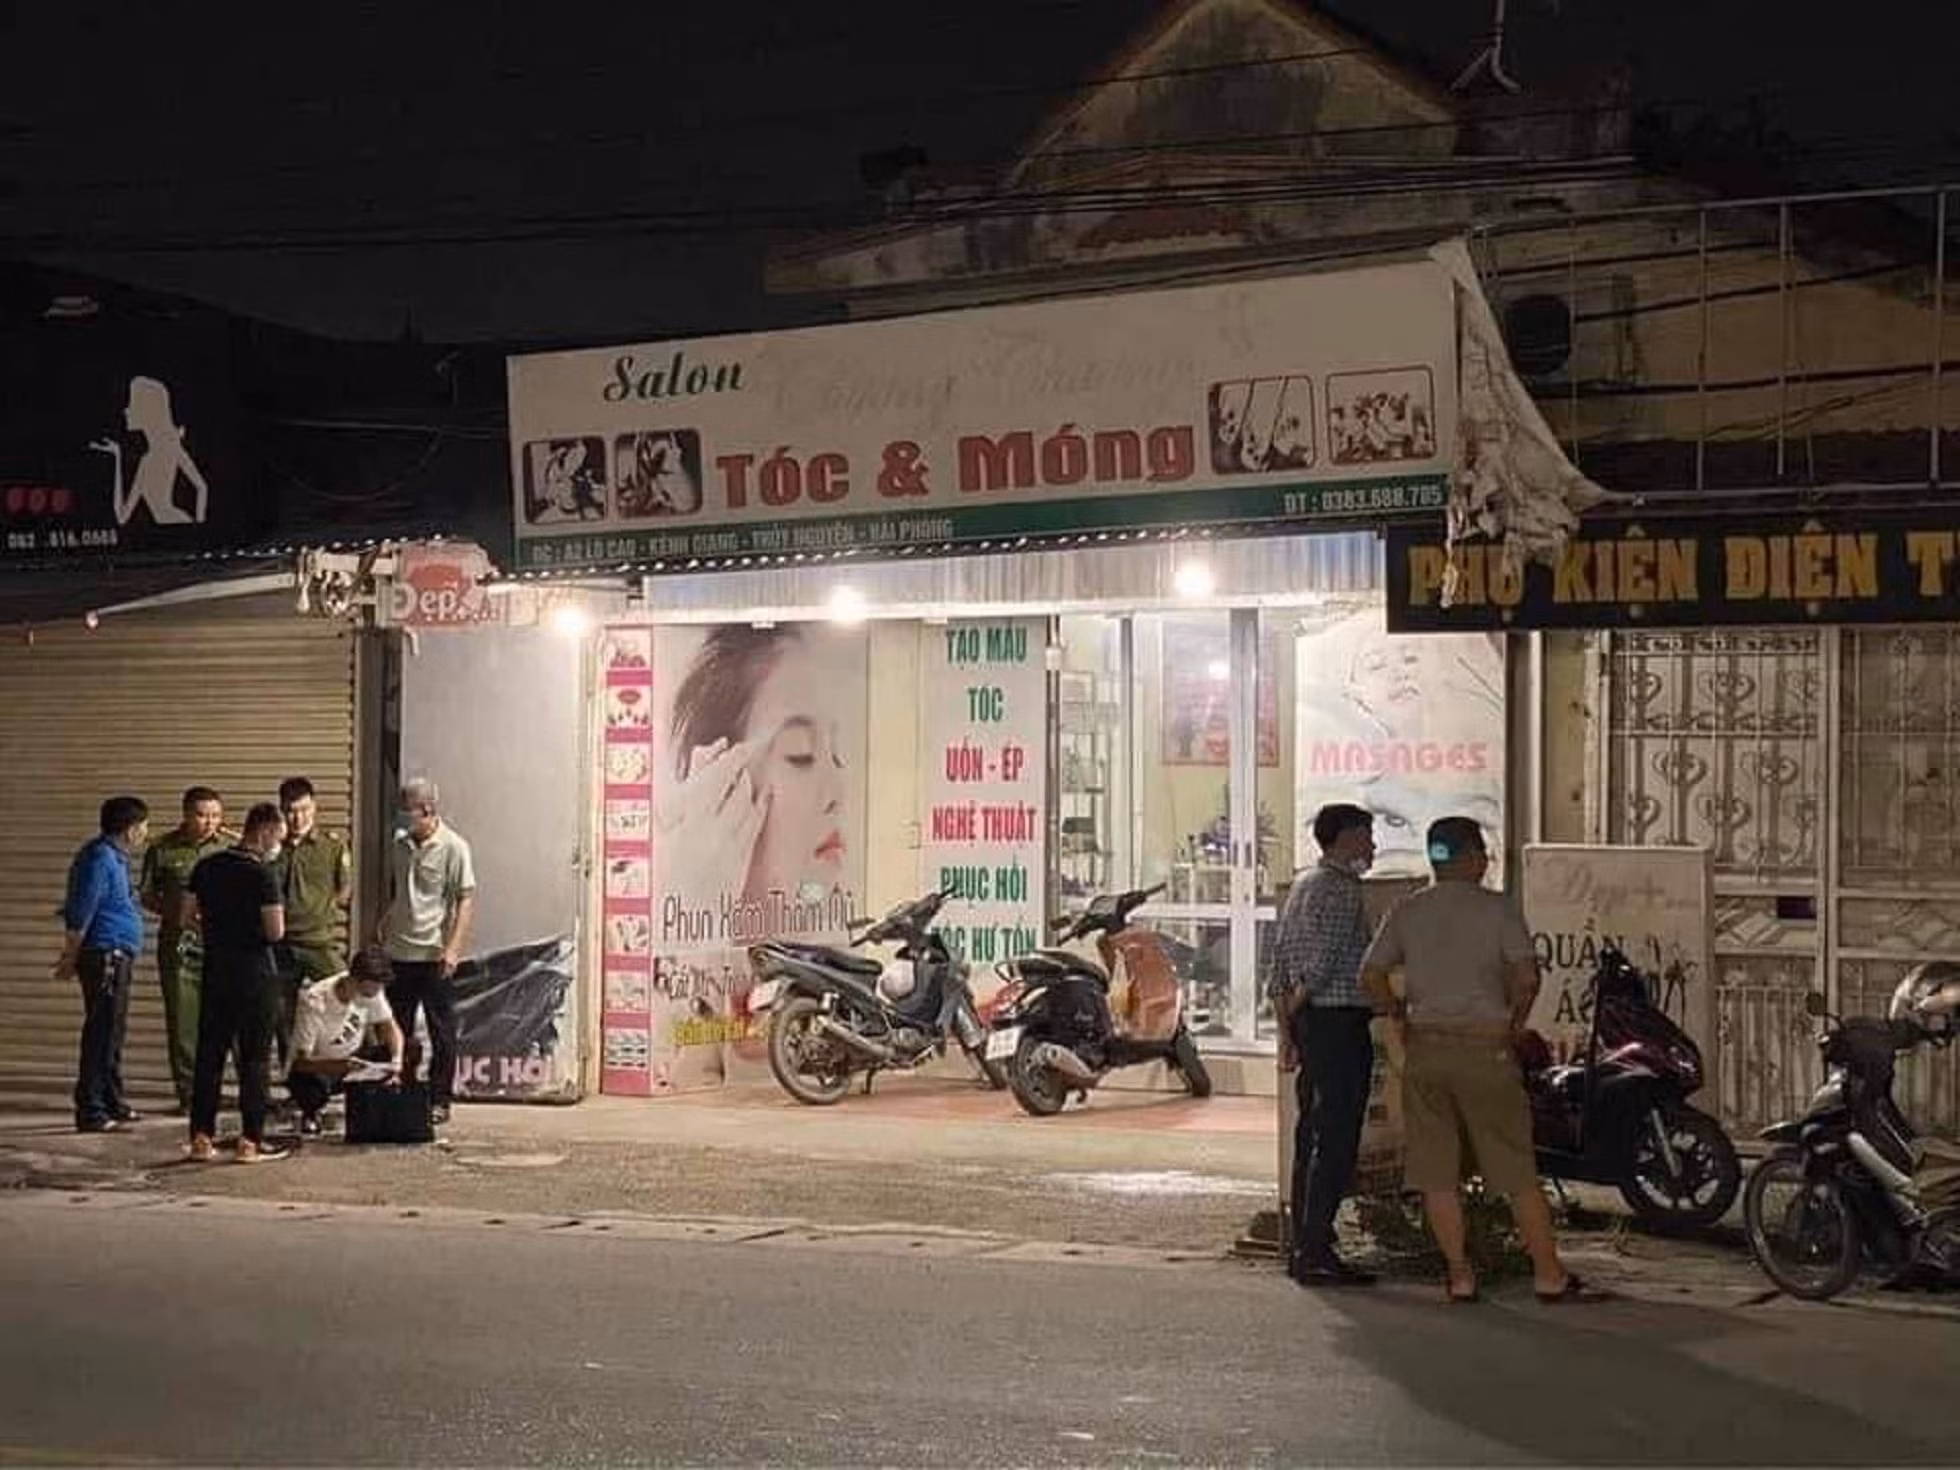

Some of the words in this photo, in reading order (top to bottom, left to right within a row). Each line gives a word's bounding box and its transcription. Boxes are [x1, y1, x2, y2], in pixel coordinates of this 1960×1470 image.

[603, 352, 744, 402] Salon
[716, 445, 851, 508] Tóc
[877, 440, 931, 498] &
[958, 423, 1196, 493] Móng
[1554, 525, 1699, 620] KIỆN
[1906, 531, 1960, 597] T
[946, 628, 981, 671] TẠO
[664, 896, 713, 942] Phun
